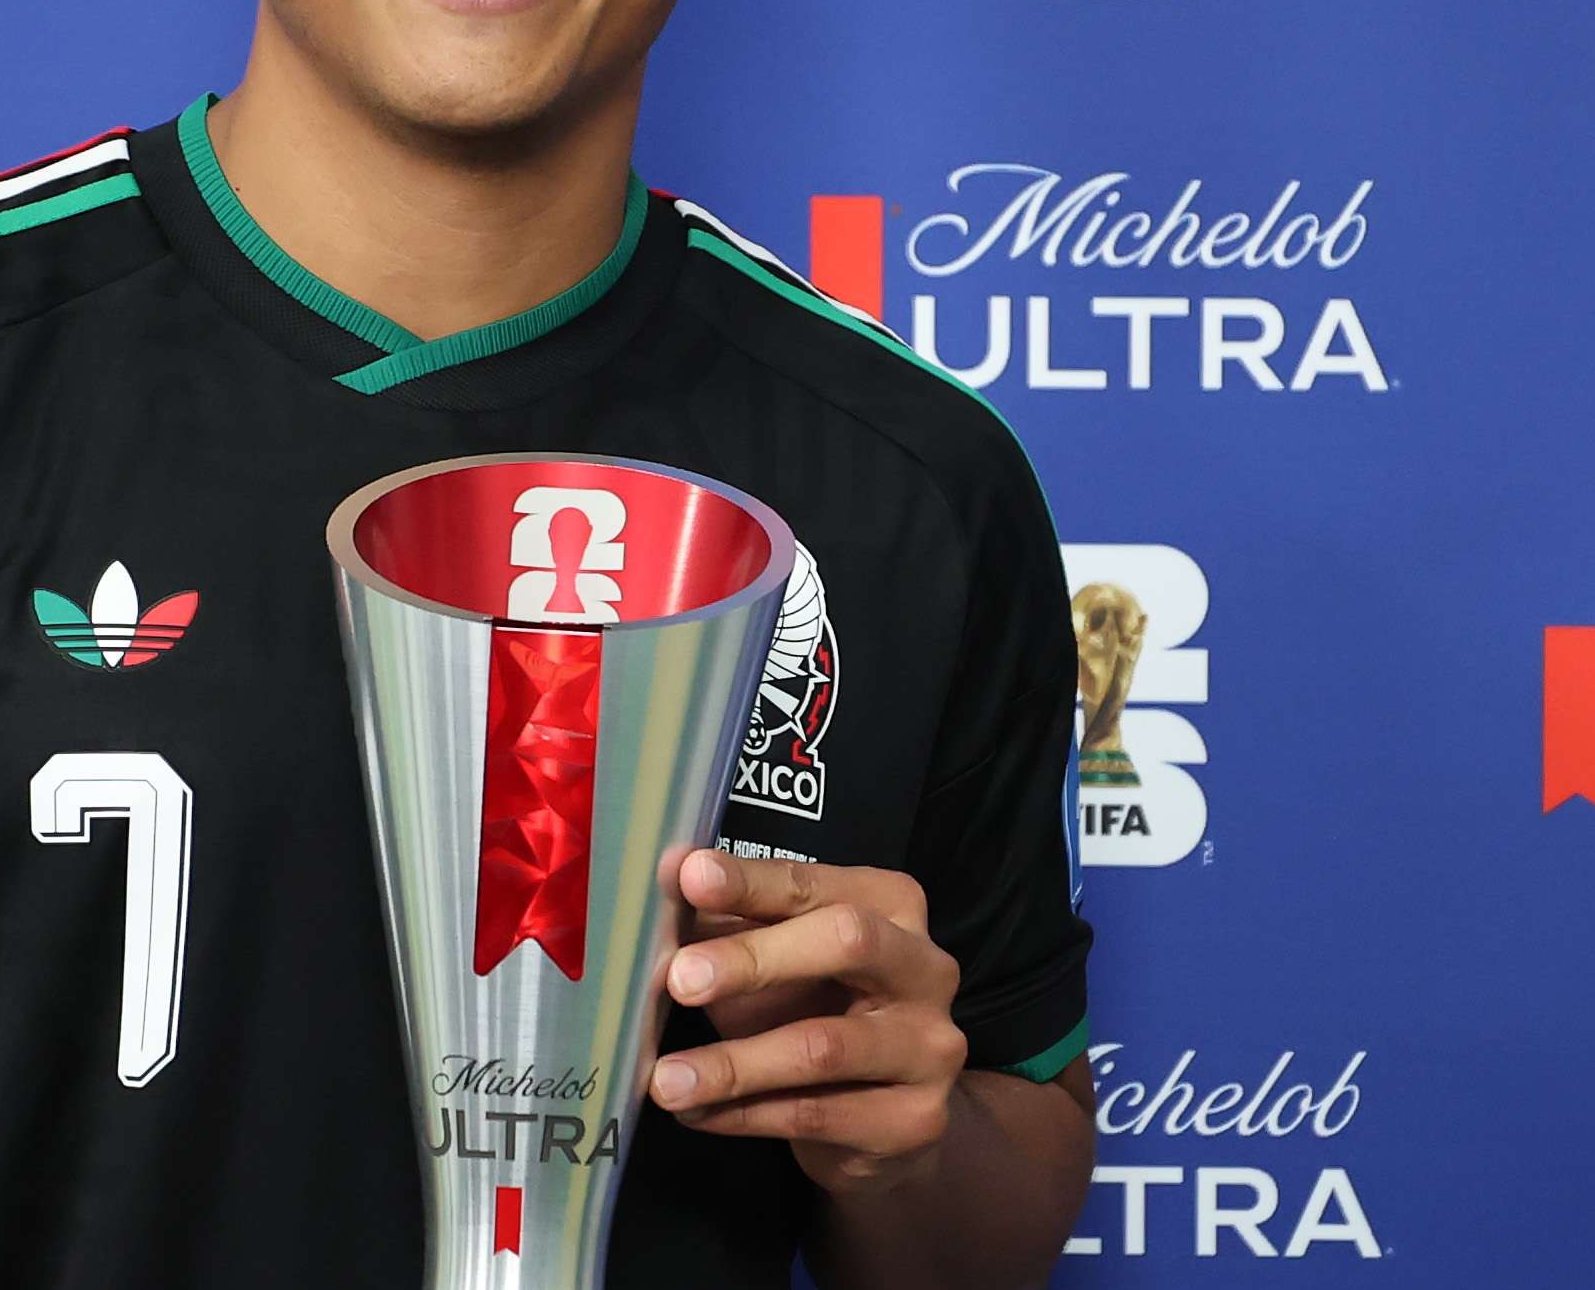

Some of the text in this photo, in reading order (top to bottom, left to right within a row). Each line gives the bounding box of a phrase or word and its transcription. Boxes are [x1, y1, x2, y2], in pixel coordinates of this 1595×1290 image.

[906, 164, 1373, 276] Michelob
[913, 295, 1388, 391] ULTRA
[734, 756, 819, 806] XICO
[1080, 804, 1151, 836] IFA
[30, 752, 193, 1088] 7
[432, 1054, 600, 1101] Michelob
[1088, 1043, 1367, 1137] chelob
[1063, 1166, 1382, 1258] TRA
